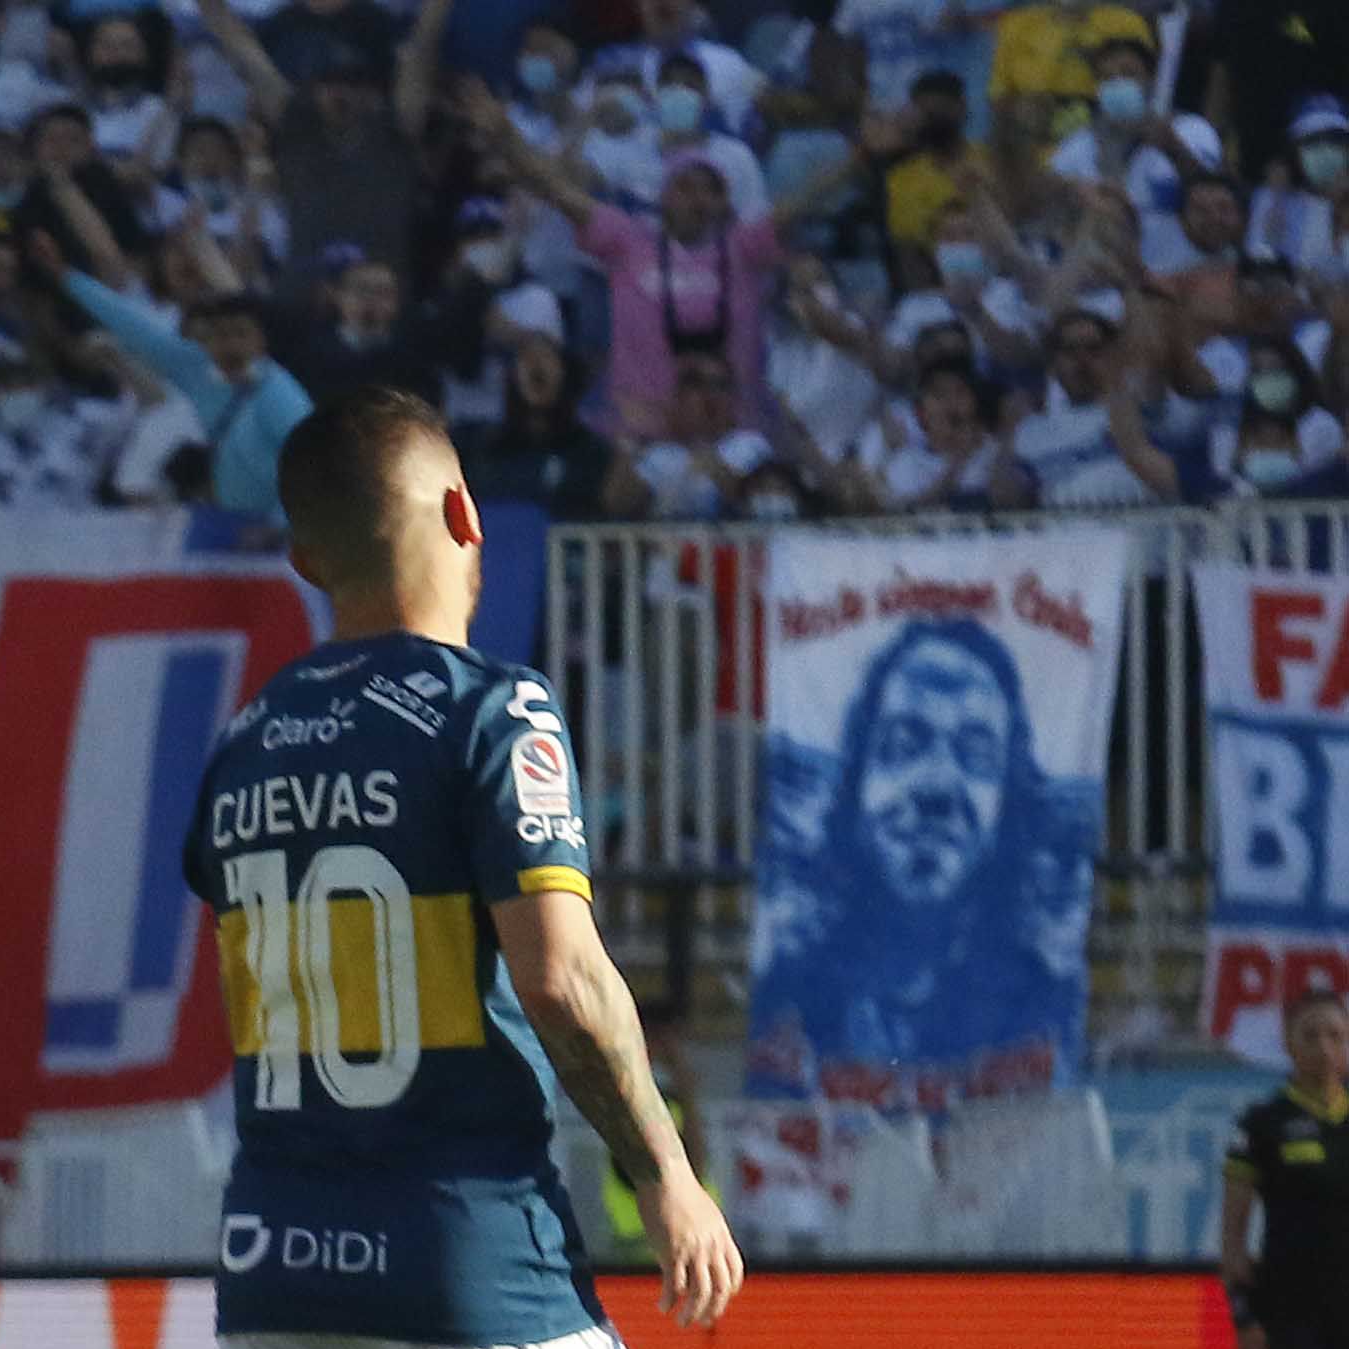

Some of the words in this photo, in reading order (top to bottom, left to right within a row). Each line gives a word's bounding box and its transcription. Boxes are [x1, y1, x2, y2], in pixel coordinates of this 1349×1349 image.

[262, 713, 340, 751] Claro
[213, 769, 401, 849] CUEVAS
[1219, 722, 1349, 907] B
[222, 845, 422, 1111] 10
[281, 1230, 389, 1275] DiDi
